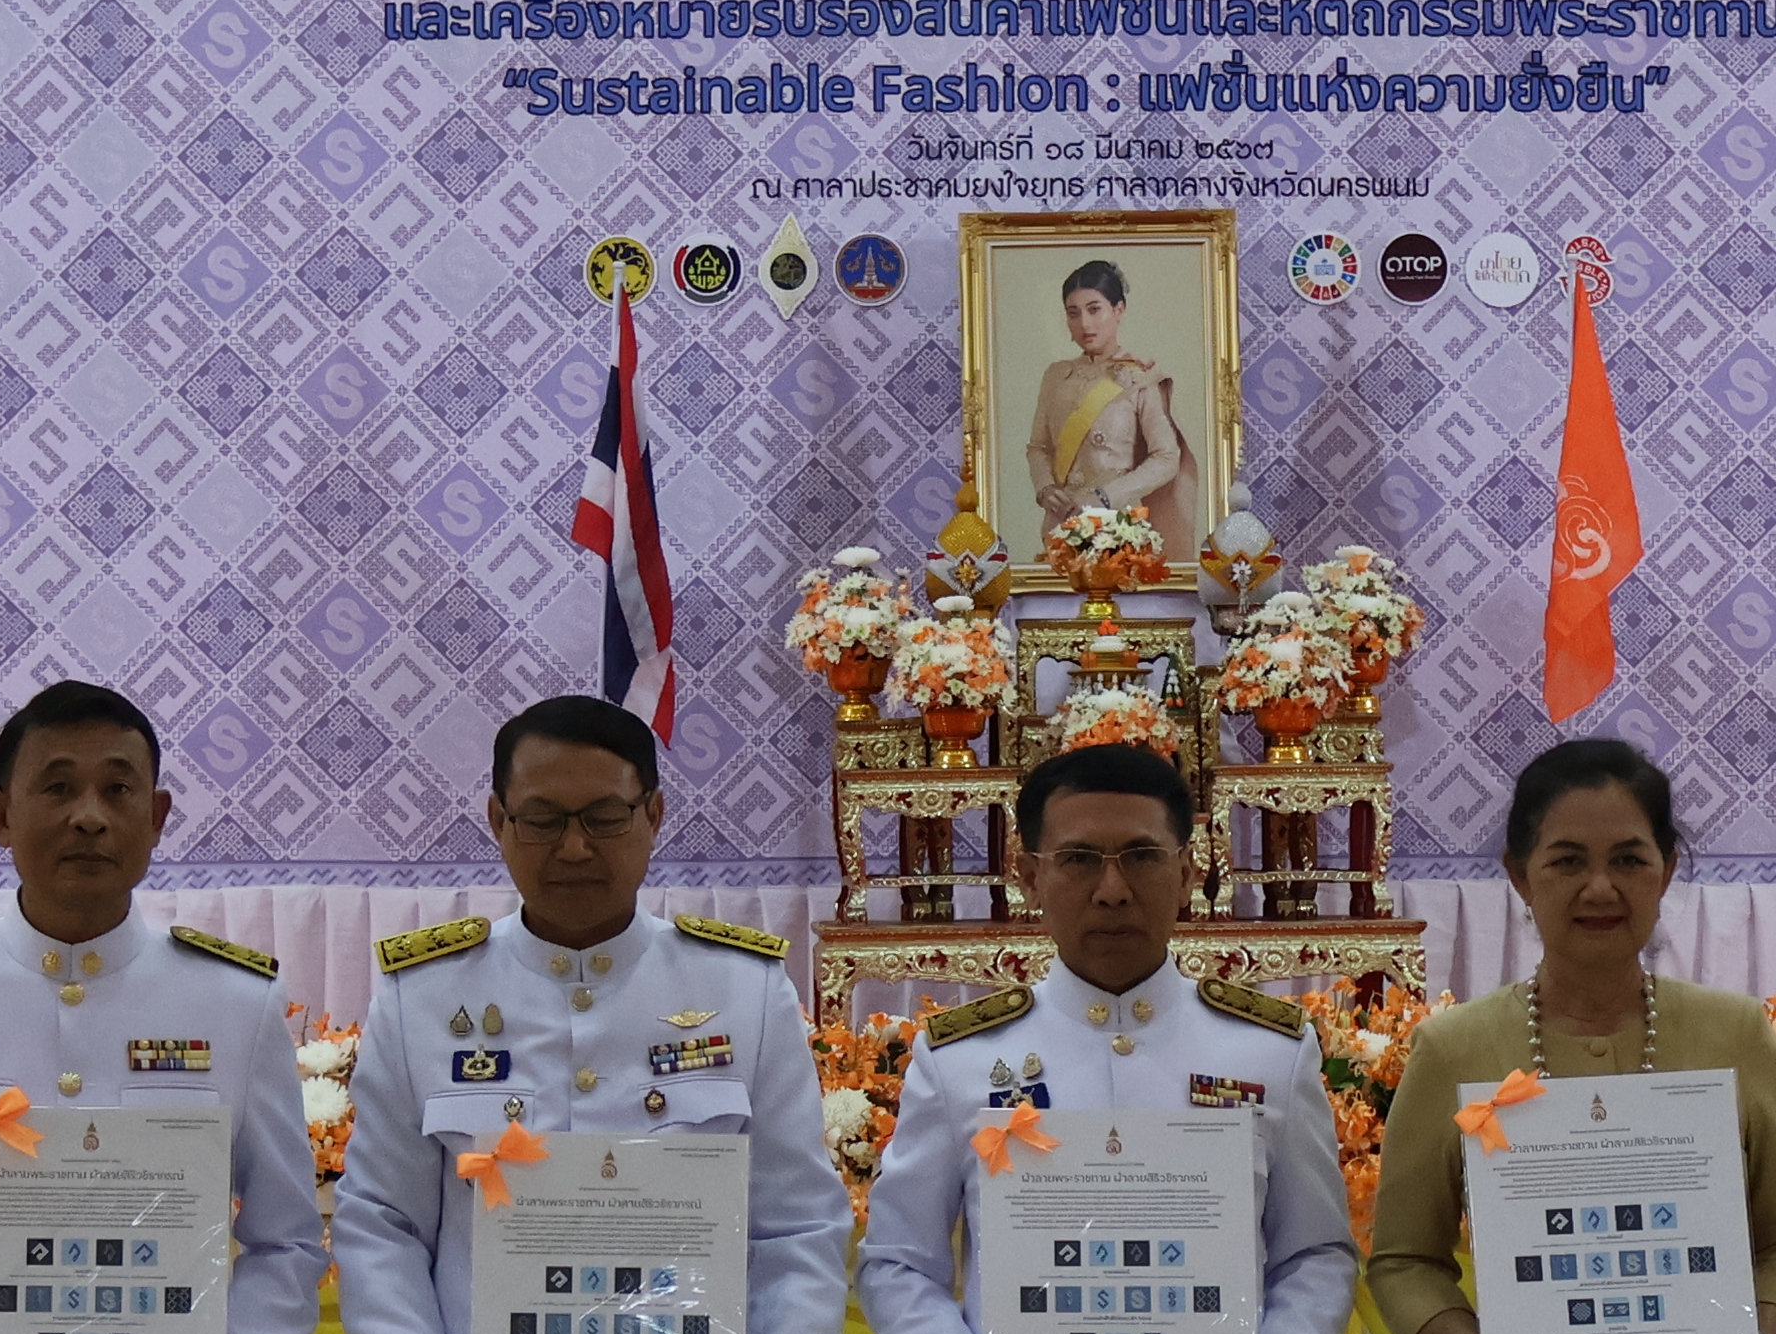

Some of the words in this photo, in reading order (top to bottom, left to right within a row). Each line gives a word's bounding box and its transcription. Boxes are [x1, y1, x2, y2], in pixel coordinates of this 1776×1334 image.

[504, 62, 855, 117] “Sustainable
[873, 62, 1089, 113] Fashion
[1106, 74, 1121, 113] :
[1139, 50, 1671, 115] แฟชั่นแห่งความยั่งยืน”
[907, 127, 1033, 161] วันจันทร์ที่
[1045, 140, 1085, 160] ๑๘
[1096, 132, 1183, 160] มีนาคม
[1194, 139, 1274, 160] ๒๕๖๗
[752, 178, 781, 199] ณ
[793, 171, 1085, 205] ศาลาประชาคมยงใจยุทธ
[1096, 170, 1430, 198] ศาลากลางจังหวัดนครพนม
[1385, 256, 1443, 273] OTOP
